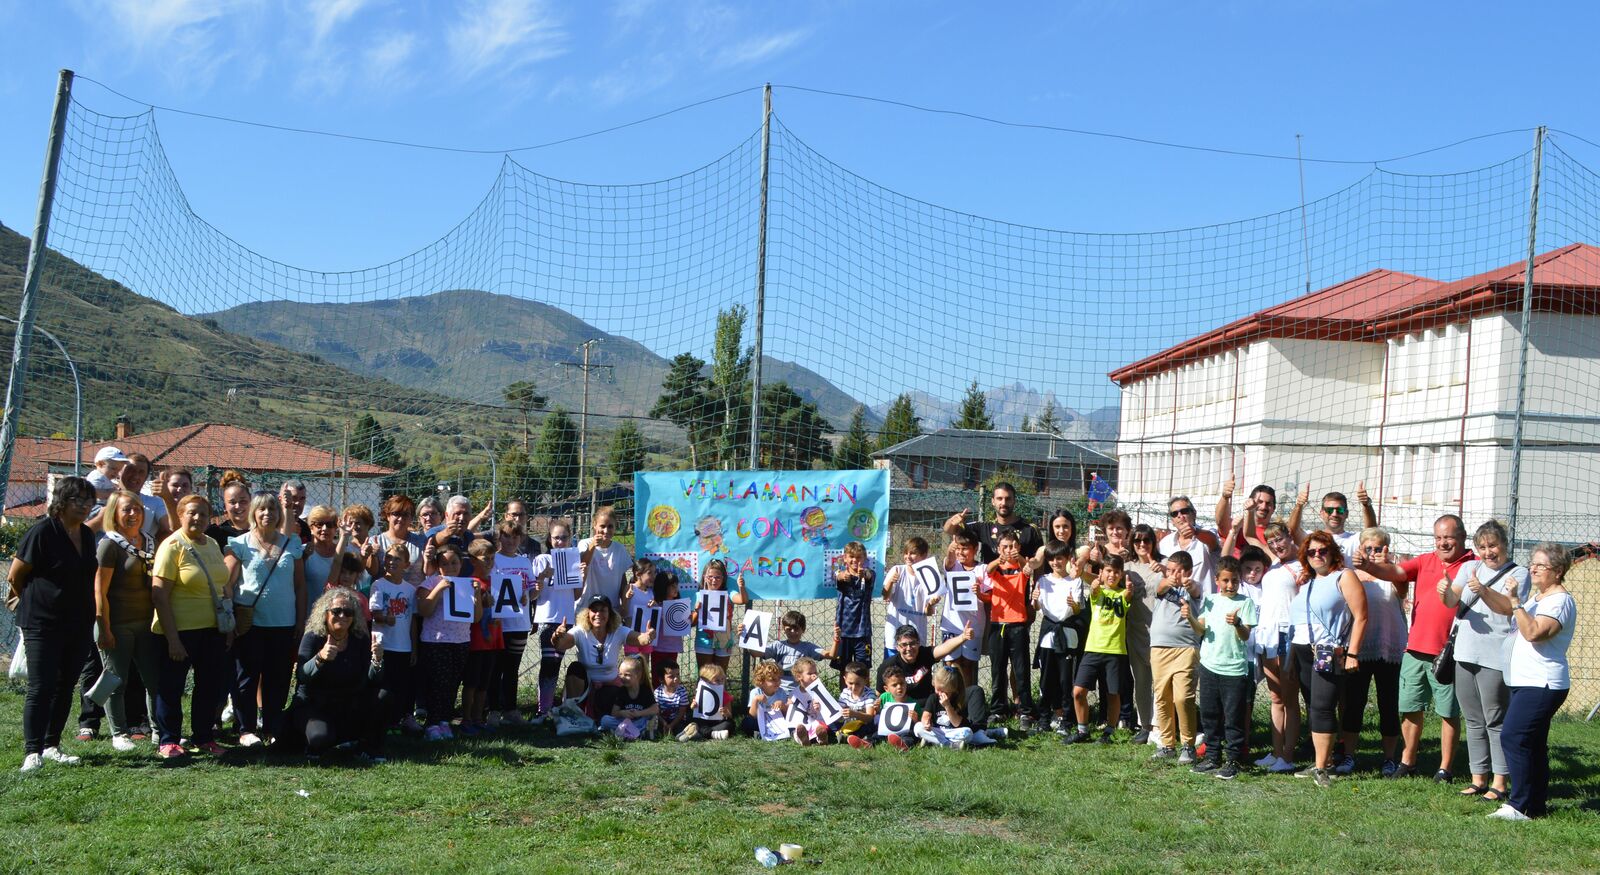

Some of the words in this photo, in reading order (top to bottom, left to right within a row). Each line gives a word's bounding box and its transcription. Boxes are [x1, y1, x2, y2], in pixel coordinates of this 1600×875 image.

[736, 516, 793, 539] CON
[556, 551, 580, 585] L
[724, 556, 806, 580] DARIO
[916, 564, 941, 596] D
[449, 581, 471, 618] L
[494, 578, 521, 613] A
[952, 576, 972, 605] E
[665, 602, 690, 631] C
[702, 594, 726, 627] H
[743, 615, 763, 647] A
[698, 685, 720, 717] D
[810, 684, 839, 717] I
[884, 703, 909, 732] O
